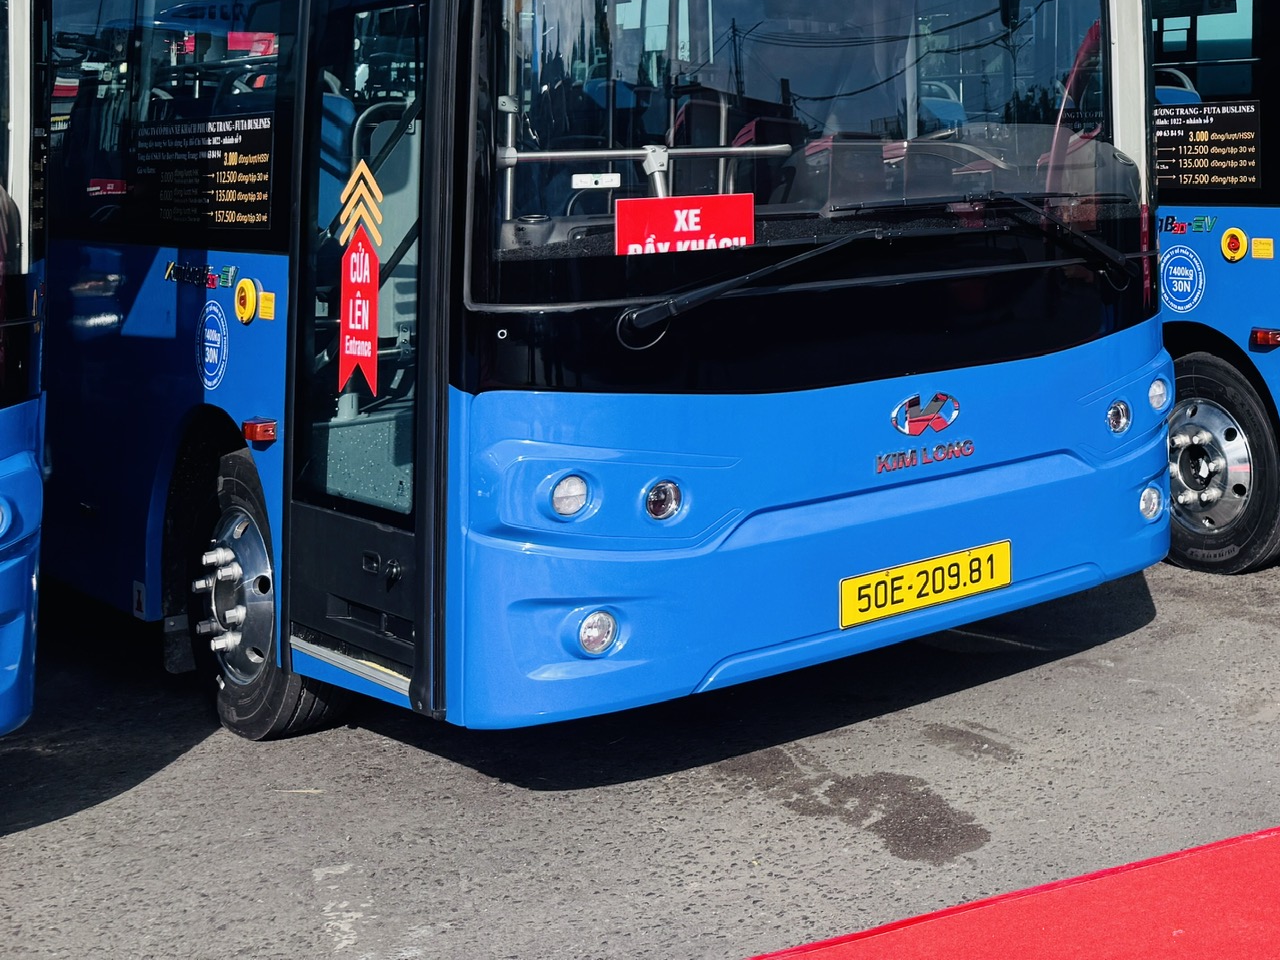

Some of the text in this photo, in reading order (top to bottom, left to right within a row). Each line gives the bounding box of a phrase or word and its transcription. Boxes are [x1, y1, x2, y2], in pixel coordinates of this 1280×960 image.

[1153, 107, 1175, 117] ƯƠNG
[1176, 106, 1199, 115] TRANG
[1203, 106, 1221, 115] FUTA
[1222, 105, 1255, 114] BUSLINES
[1177, 129, 1184, 137] 94
[1188, 130, 1209, 142] 3.000
[1179, 144, 1209, 155] 112.500
[1239, 146, 1247, 154] 30
[1247, 145, 1256, 153] vé
[224, 151, 238, 166] 3.000
[1179, 158, 1209, 168] 135.000
[1239, 159, 1247, 167] 30
[1247, 159, 1256, 167] vé
[216, 171, 237, 184] 112.500
[1179, 173, 1209, 185] 157.500
[1239, 175, 1247, 183] 30
[1248, 174, 1256, 183] vé
[215, 190, 236, 202] 135.000
[215, 210, 236, 223] 157.500
[673, 208, 702, 232] XE
[350, 242, 371, 283] CỬA
[1168, 266, 1194, 278] 7400kg
[1172, 280, 1191, 292] 30N
[349, 290, 369, 330] LÊN
[344, 335, 372, 357] Entrance
[204, 347, 219, 364] 30N
[876, 439, 976, 474] KIM LONG
[857, 553, 995, 613] 50E-209.81
